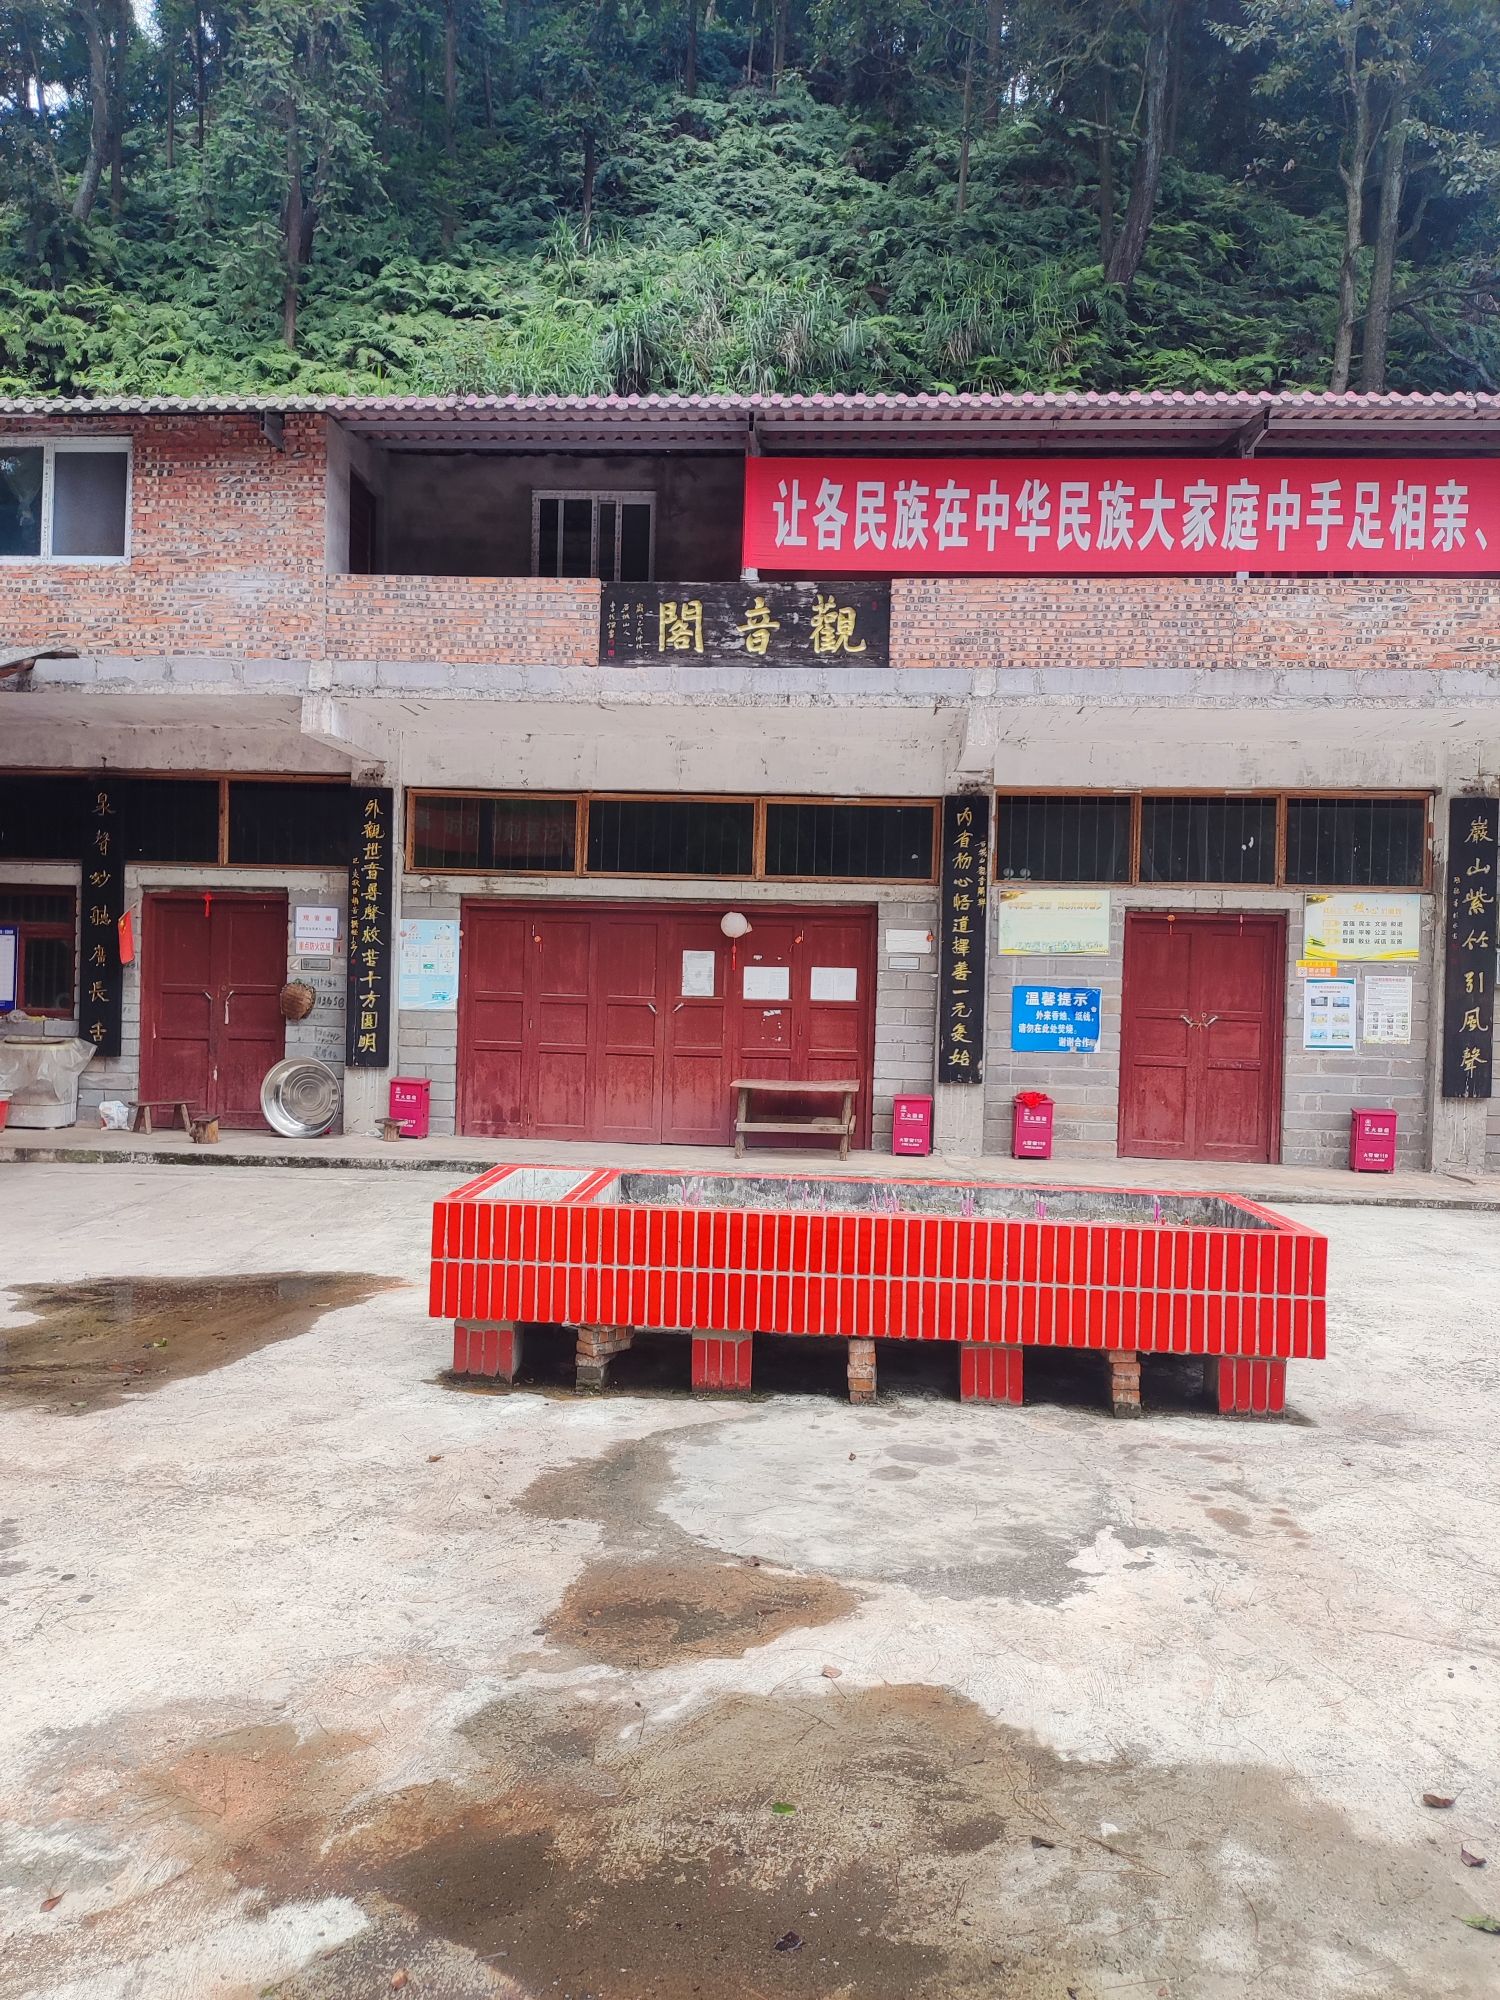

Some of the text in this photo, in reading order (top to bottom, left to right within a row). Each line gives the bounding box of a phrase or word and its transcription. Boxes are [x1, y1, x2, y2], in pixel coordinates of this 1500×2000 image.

[773, 477, 1487, 554] 让各民族在中华民族大家庭中手足相亲、
[1025, 991, 1088, 1007] 温馨提示
